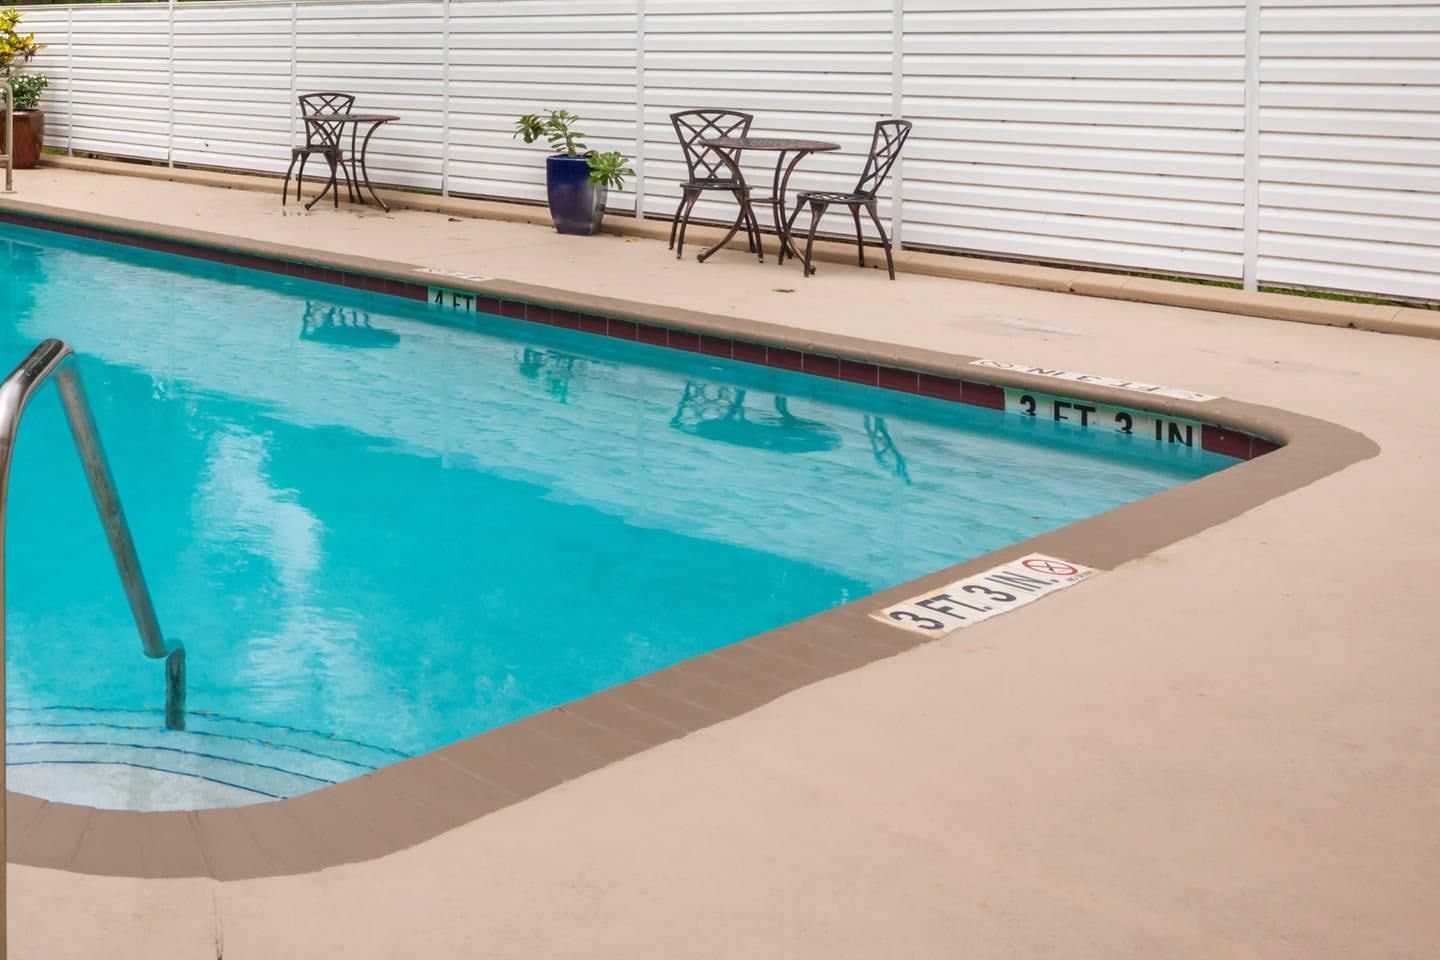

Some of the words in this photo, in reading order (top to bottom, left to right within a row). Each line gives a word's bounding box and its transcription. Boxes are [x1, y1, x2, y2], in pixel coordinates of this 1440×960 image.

[453, 292, 474, 310] FT
[1019, 394, 1037, 417] 3
[1053, 399, 1096, 427] FT
[1114, 411, 1134, 435] 3
[1154, 418, 1193, 448] IN
[983, 570, 1060, 592] IN.
[961, 584, 1017, 603] 3
[913, 593, 993, 620] FT.
[889, 610, 945, 631] 3
